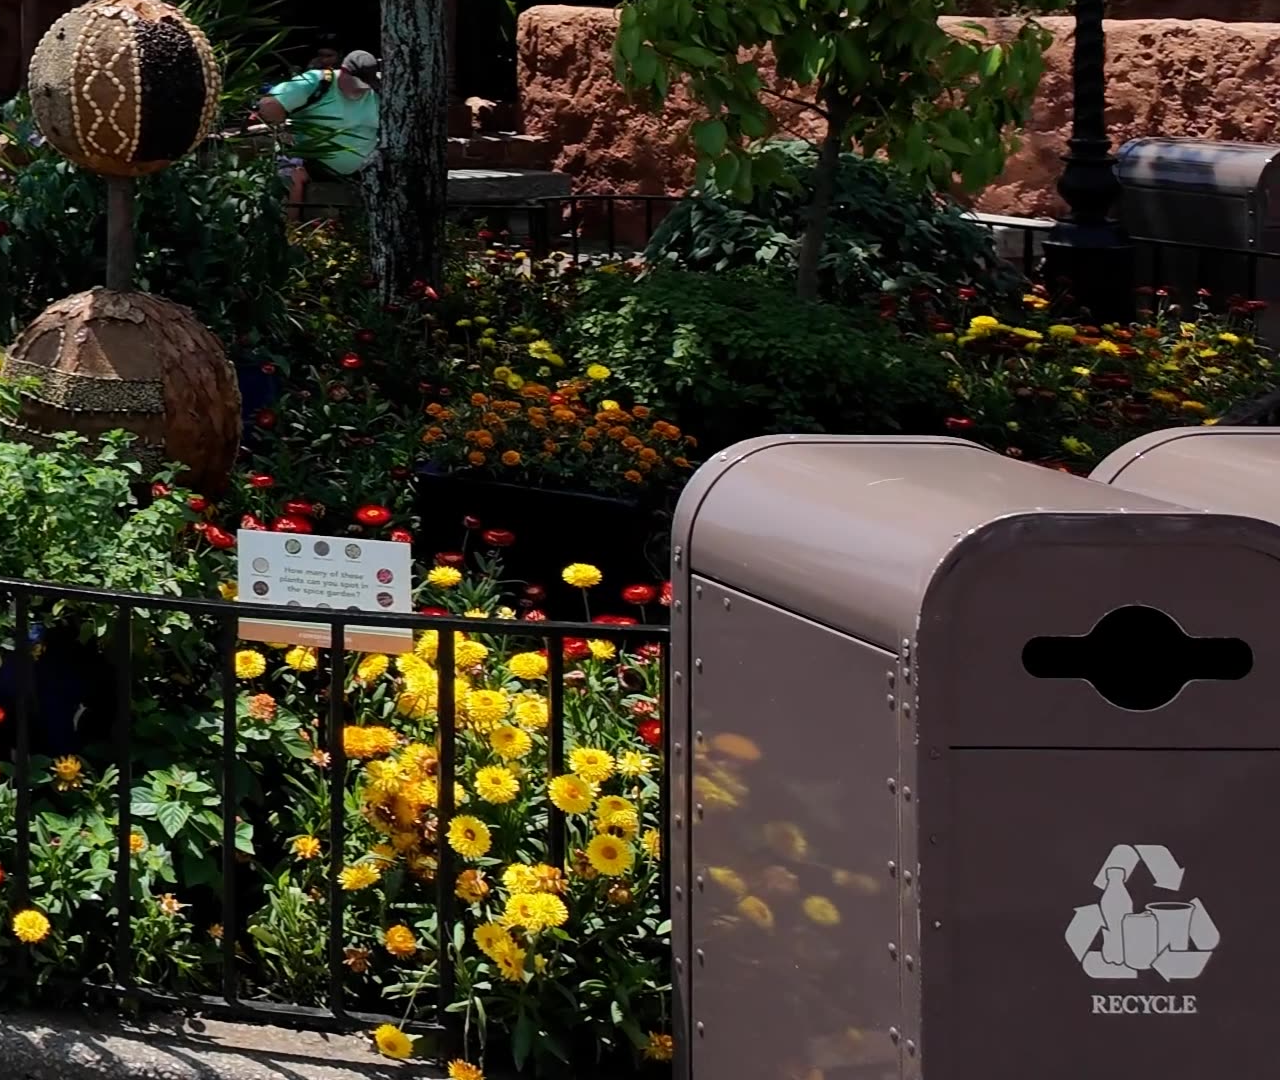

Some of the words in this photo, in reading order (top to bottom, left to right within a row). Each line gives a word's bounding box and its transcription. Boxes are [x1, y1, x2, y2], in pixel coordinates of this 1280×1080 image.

[284, 567, 303, 575] How
[306, 570, 327, 578] many
[329, 570, 339, 578] of
[341, 572, 364, 580] these
[279, 576, 304, 584] plants
[303, 588, 324, 596] spice
[326, 590, 361, 599] garden?
[1091, 994, 1198, 1014] RECYCLE
